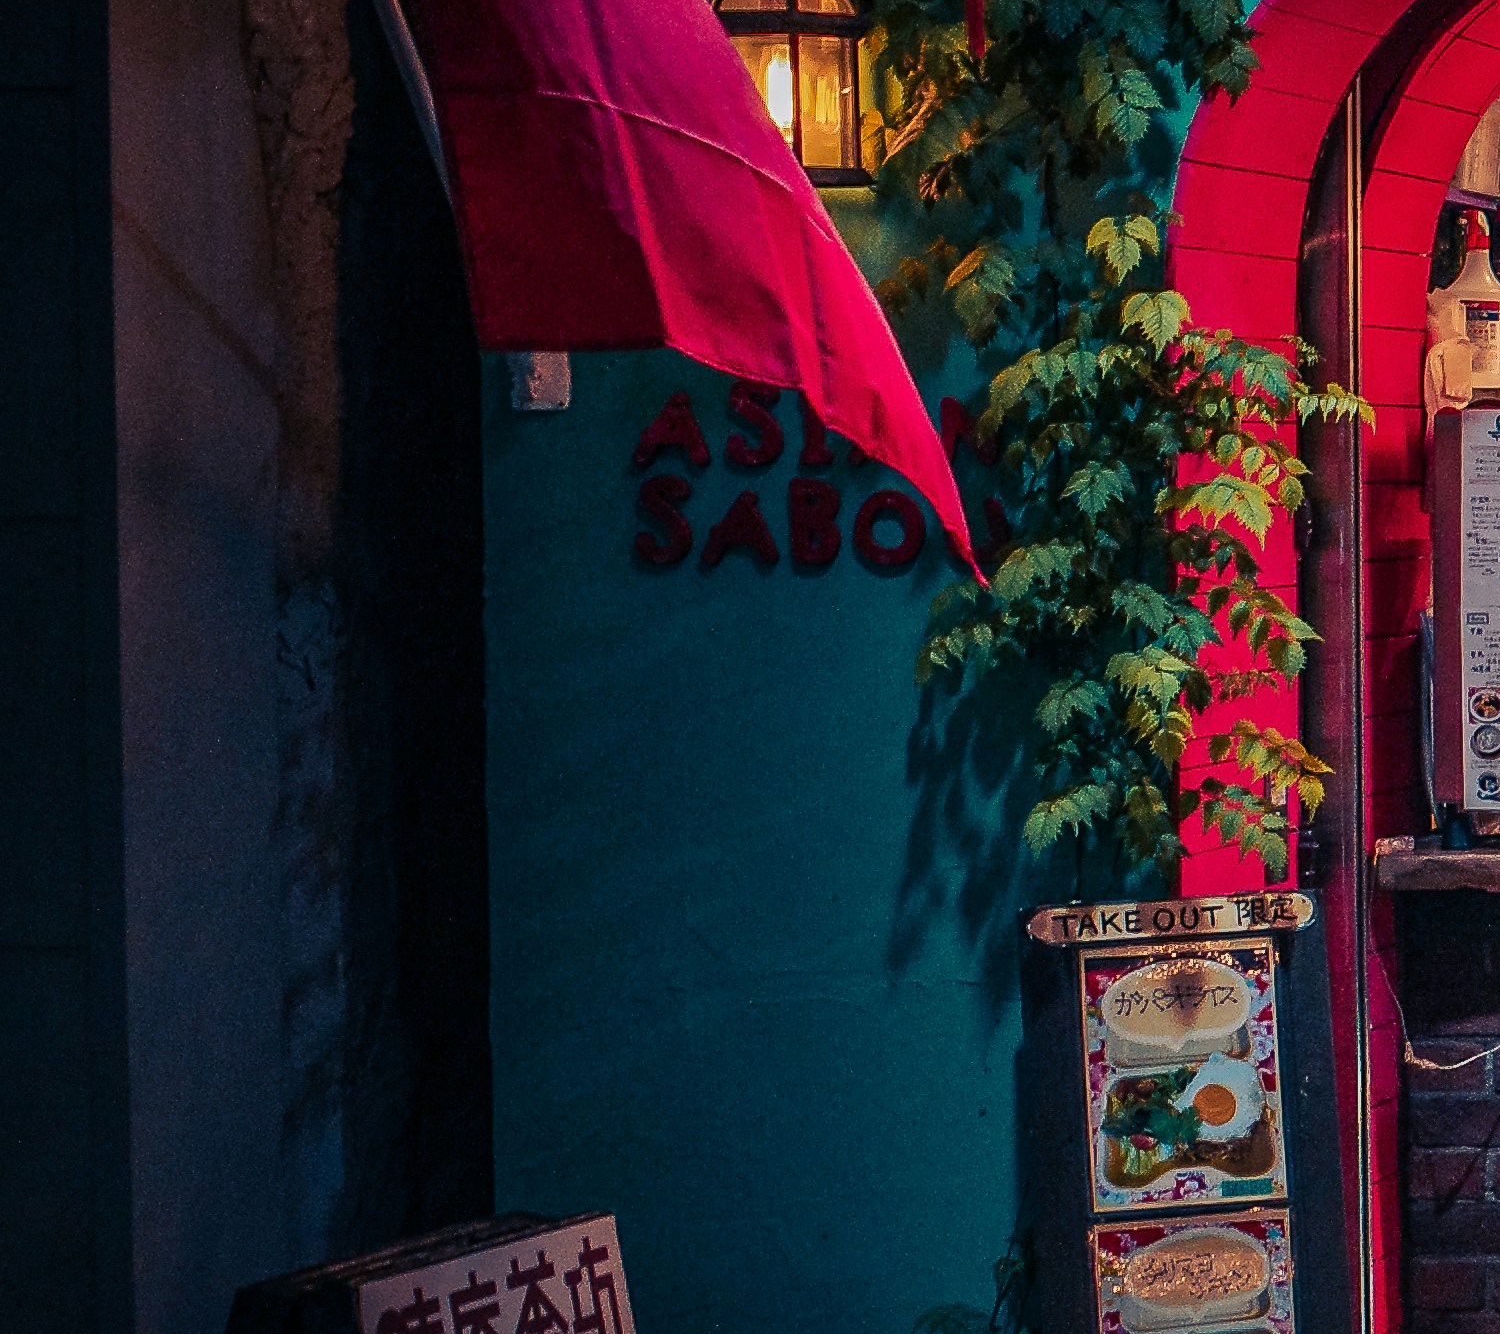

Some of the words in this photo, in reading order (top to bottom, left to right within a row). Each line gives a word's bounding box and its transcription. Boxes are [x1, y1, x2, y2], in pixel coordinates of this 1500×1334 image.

[1051, 908, 1143, 938] TAKE
[1152, 905, 1224, 932] OUT
[1234, 895, 1299, 927] 限定
